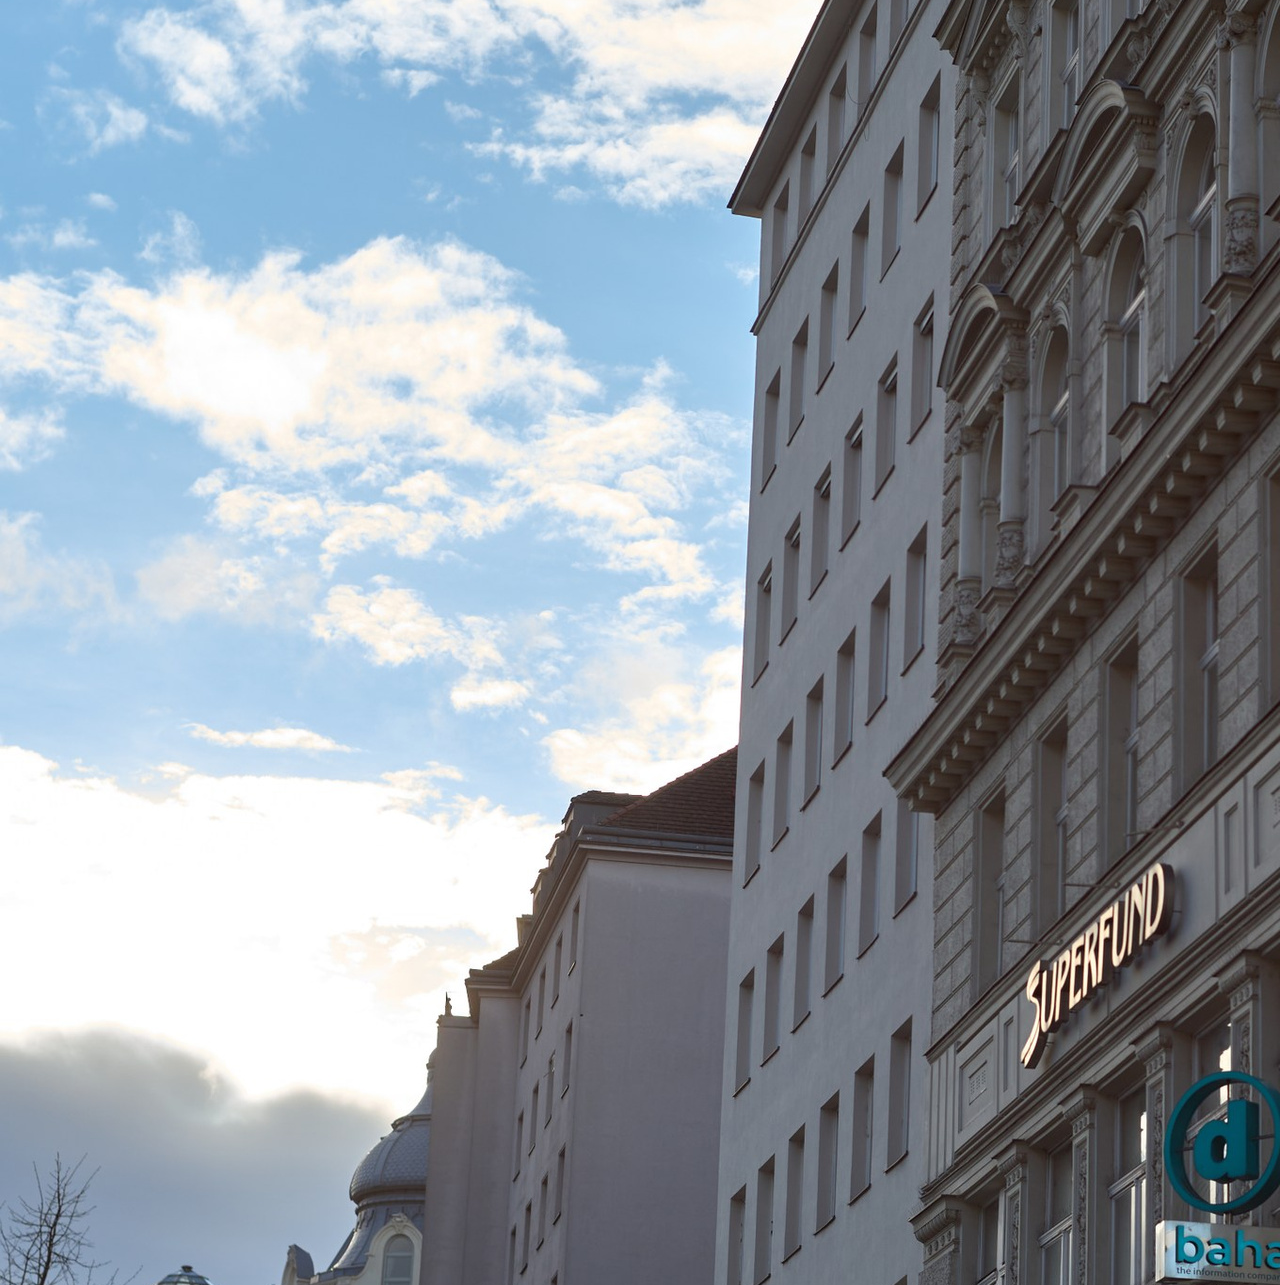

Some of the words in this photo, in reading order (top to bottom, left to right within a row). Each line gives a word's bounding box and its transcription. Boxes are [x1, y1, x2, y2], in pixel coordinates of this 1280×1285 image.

[1021, 863, 1170, 1068] SUPERFUND
[1176, 1267, 1191, 1275] the
[1193, 1267, 1245, 1279] information
